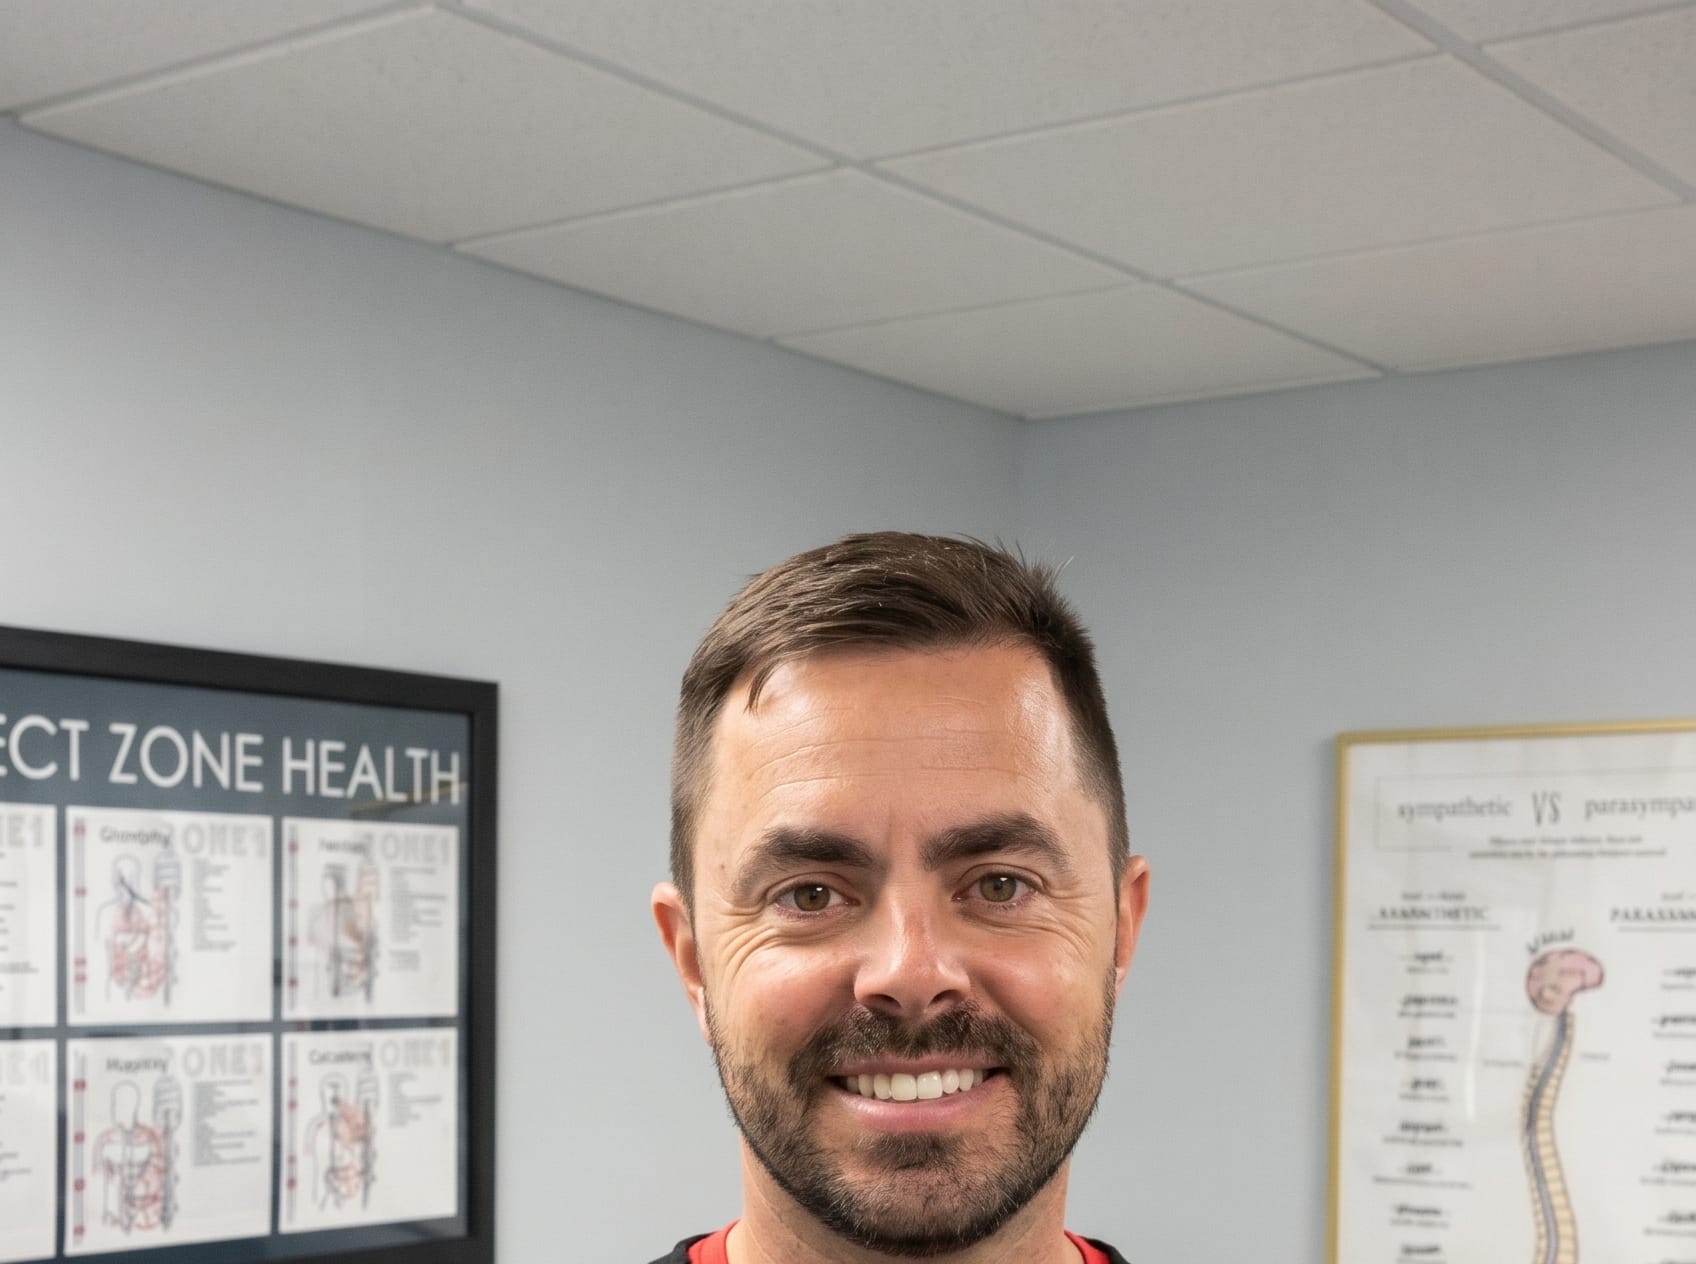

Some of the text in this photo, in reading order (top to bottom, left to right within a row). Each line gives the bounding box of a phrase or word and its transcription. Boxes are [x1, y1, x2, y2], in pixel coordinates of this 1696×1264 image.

[0, 713, 460, 806] CT ZONE HEALTH
[1532, 790, 1561, 827] VS
